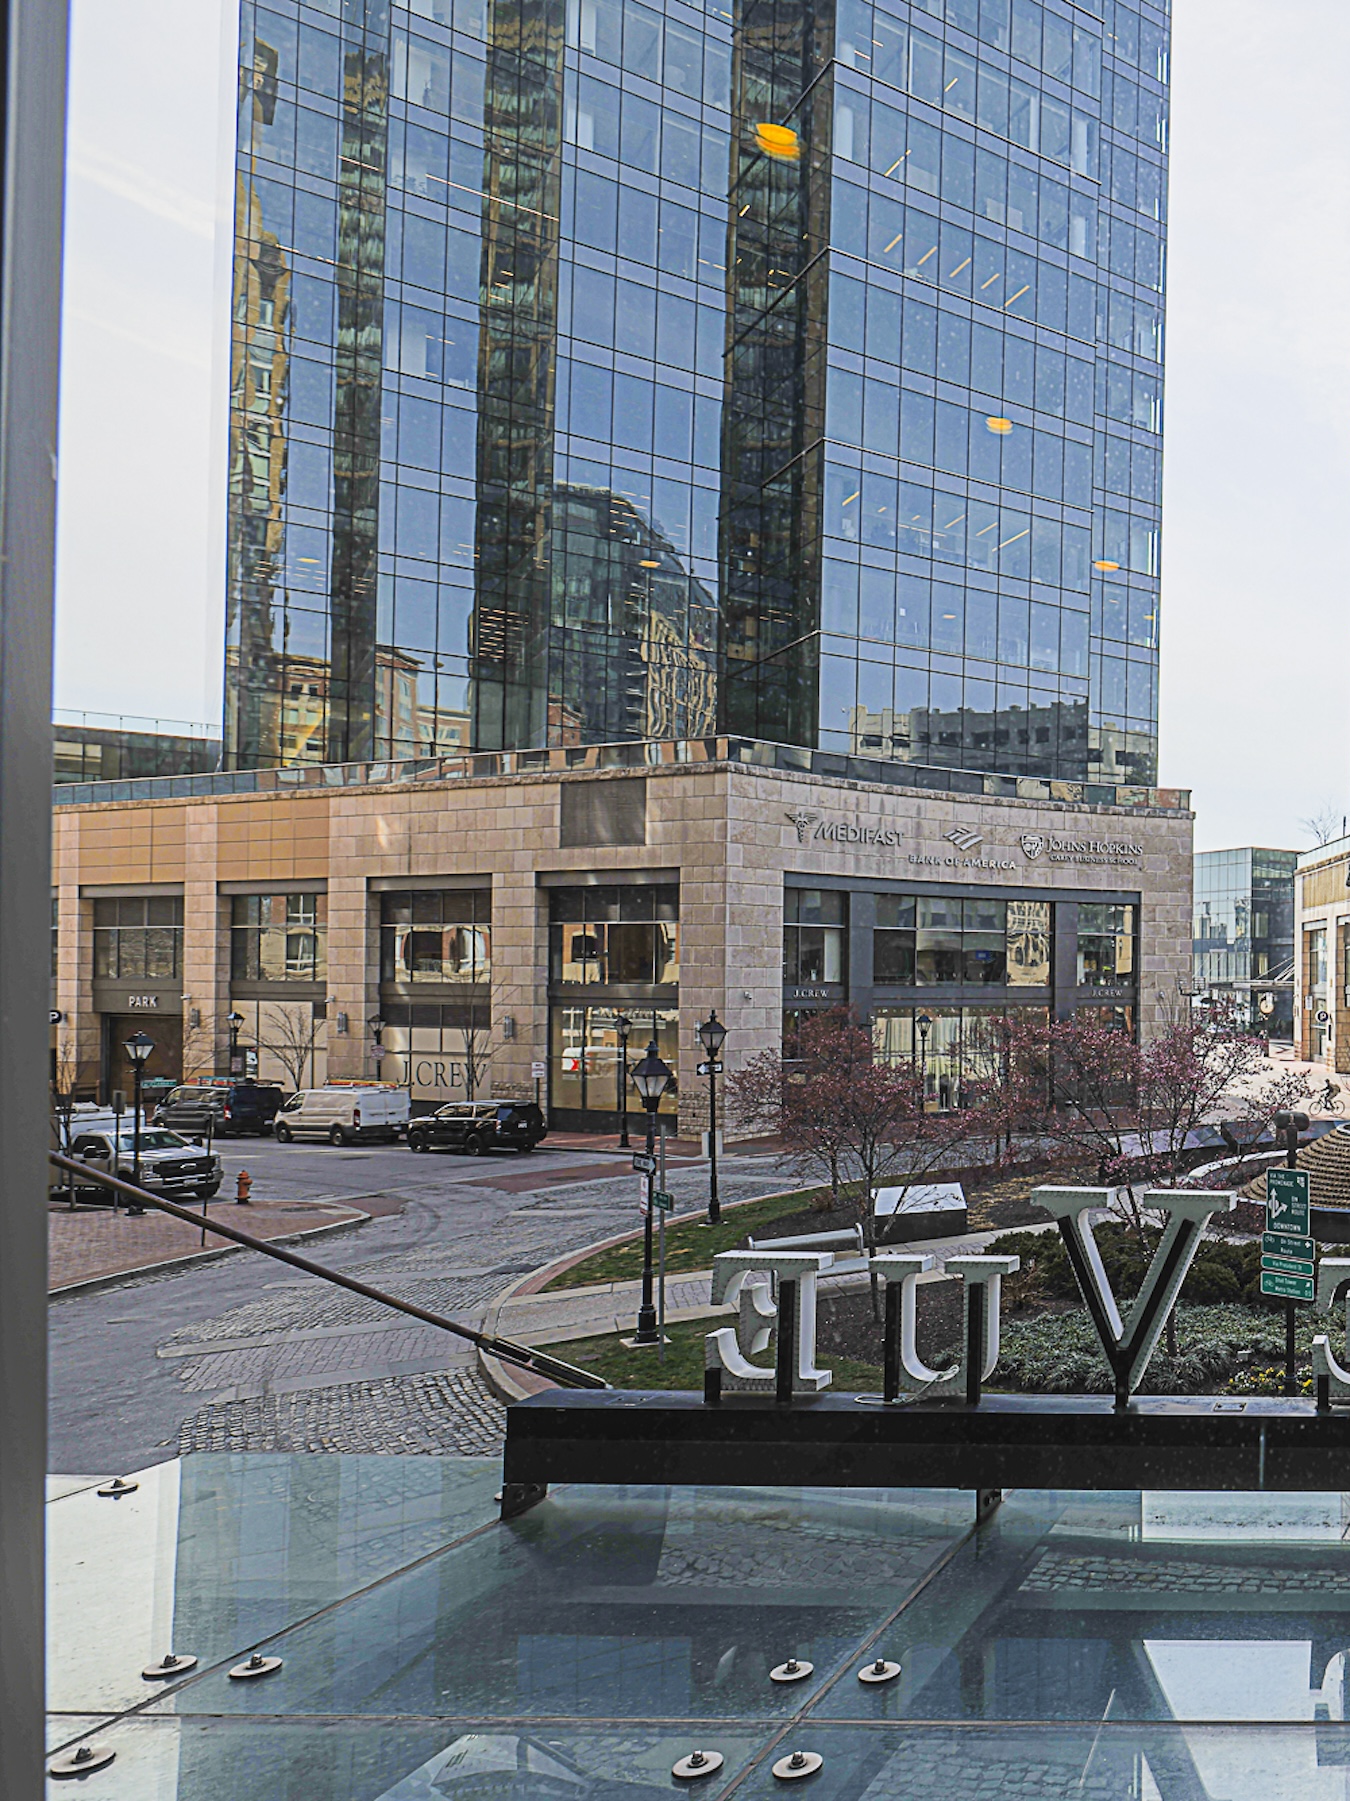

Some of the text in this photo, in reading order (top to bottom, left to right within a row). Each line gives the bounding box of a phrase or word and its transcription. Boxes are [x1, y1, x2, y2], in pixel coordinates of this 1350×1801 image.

[814, 821, 904, 846] MEDIFAST
[1046, 836, 1143, 856] JOHNS HOPKINS
[908, 854, 1016, 870] BANK OF AMERICA
[128, 995, 158, 1009] PARK
[397, 1060, 487, 1088] J.CREW
[1273, 1222, 1301, 1231] DOWNTOWN
